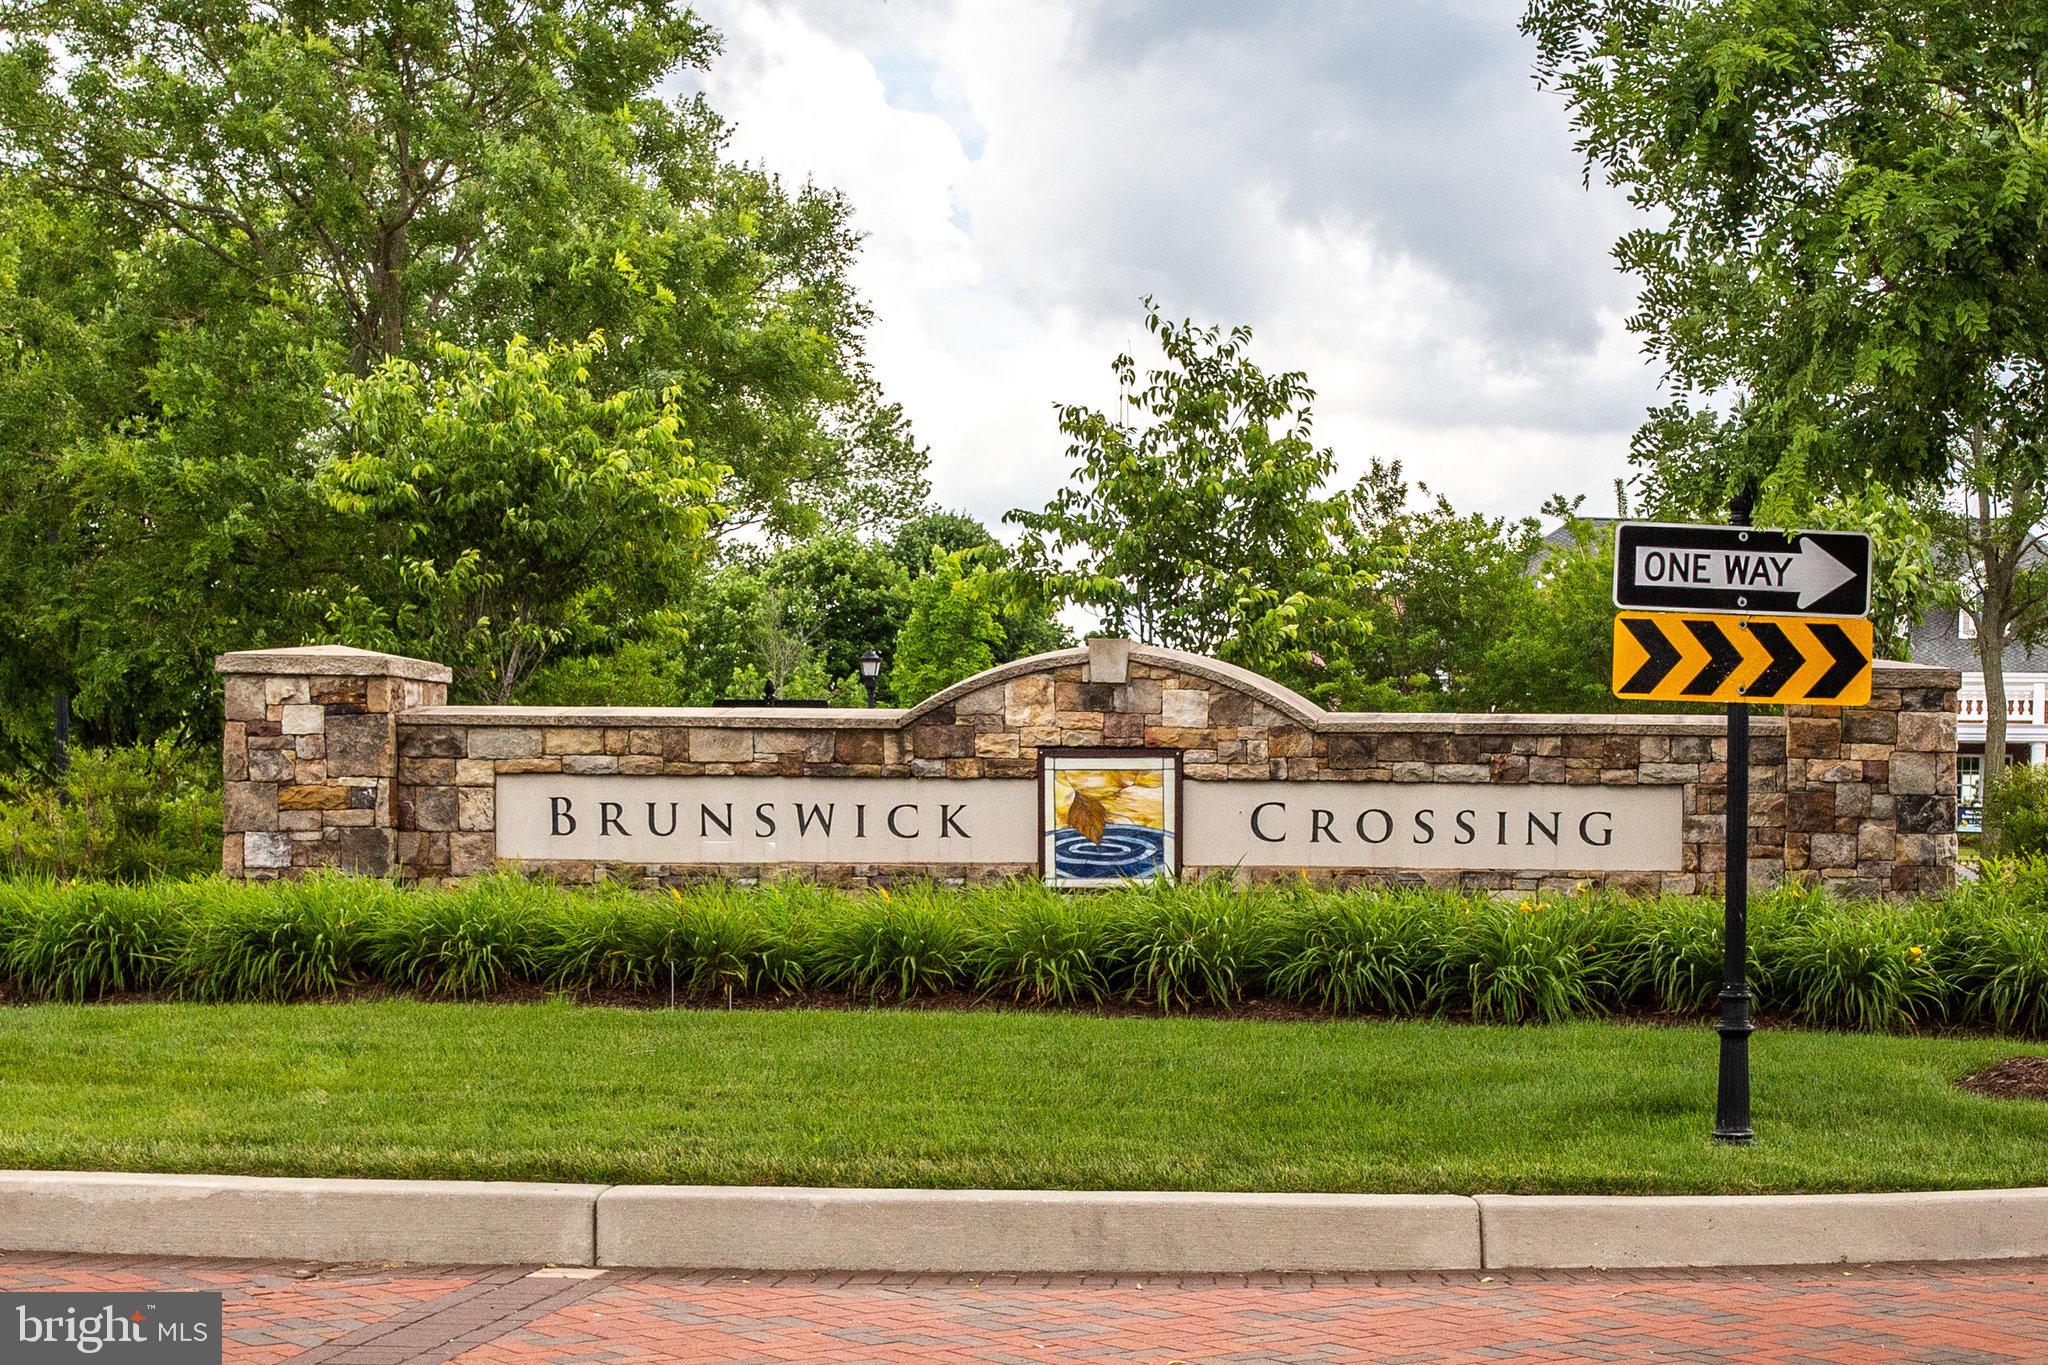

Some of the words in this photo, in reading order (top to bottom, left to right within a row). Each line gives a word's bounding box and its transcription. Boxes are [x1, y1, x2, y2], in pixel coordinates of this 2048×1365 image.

[1644, 551, 1711, 584] ONE
[1725, 554, 1794, 587] WAY
[549, 796, 971, 839] BRUNSWICK
[1250, 801, 1613, 846] CROSSING
